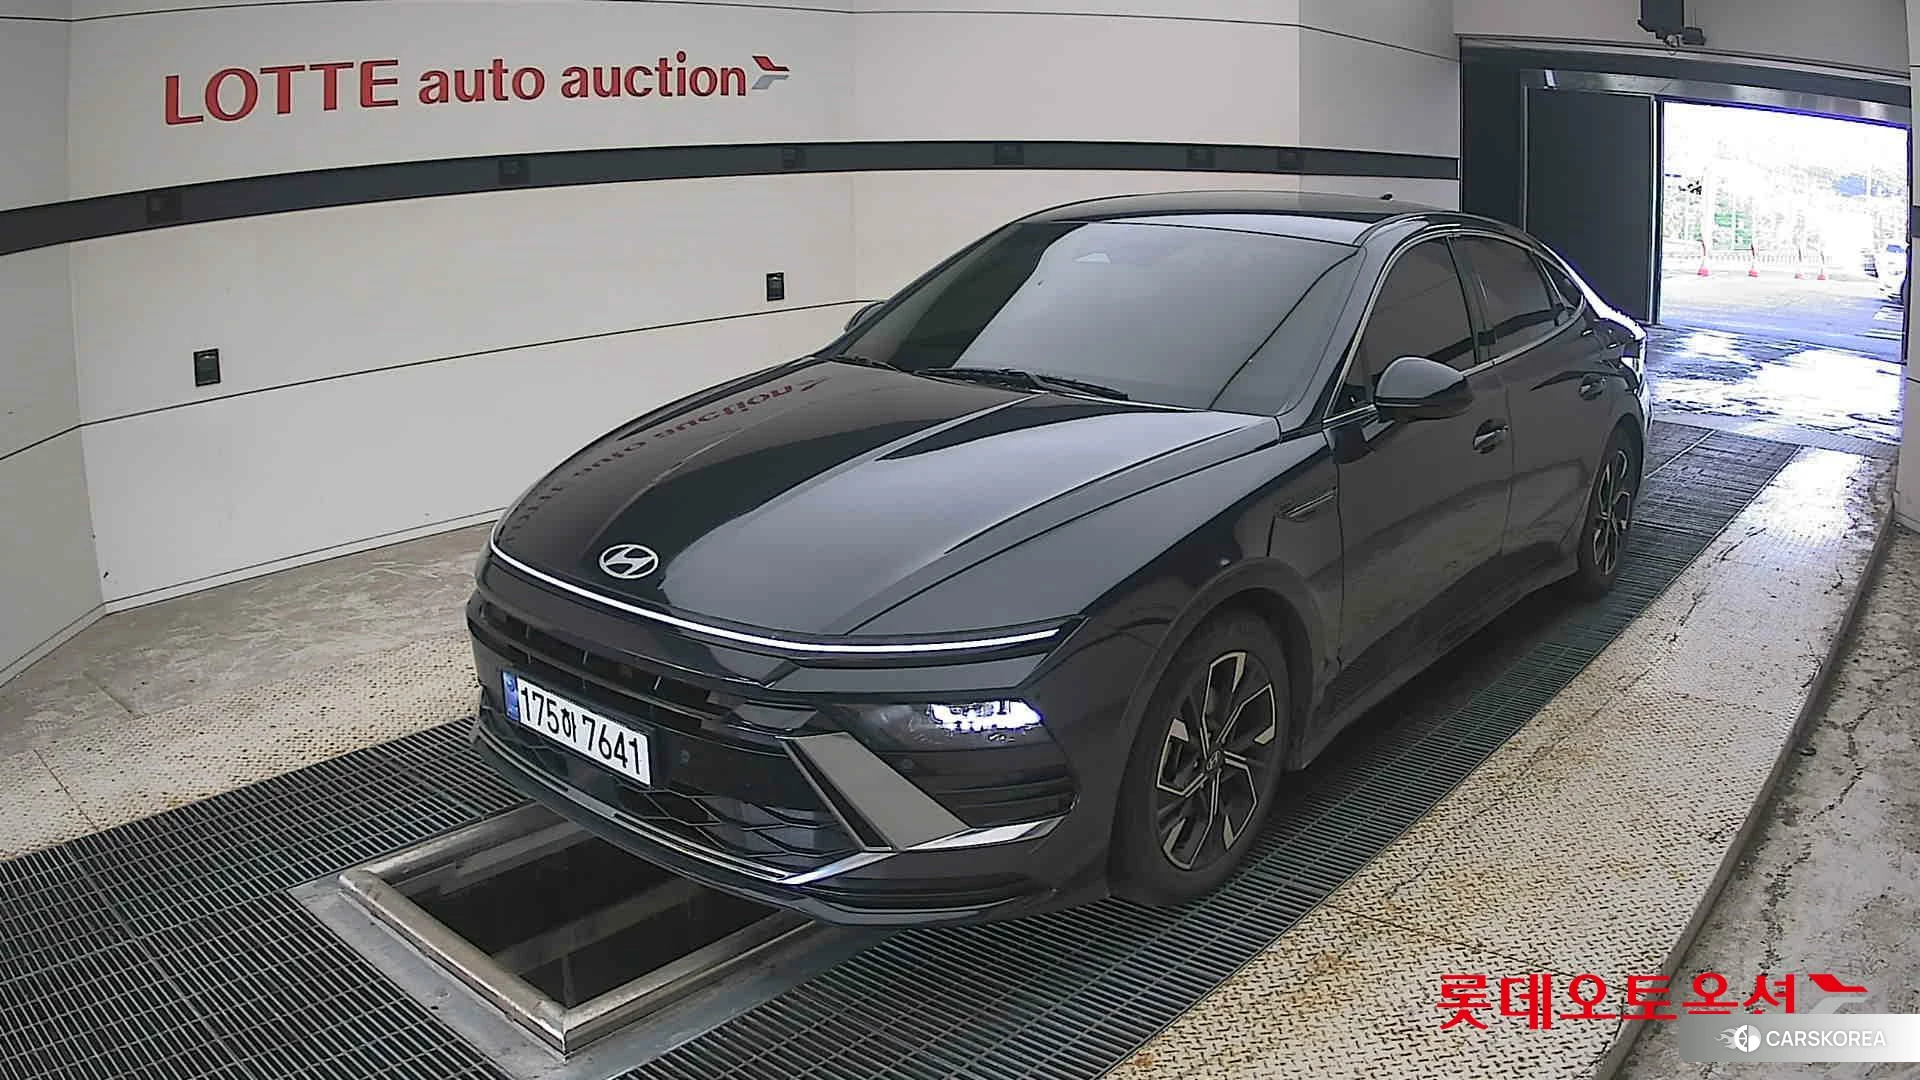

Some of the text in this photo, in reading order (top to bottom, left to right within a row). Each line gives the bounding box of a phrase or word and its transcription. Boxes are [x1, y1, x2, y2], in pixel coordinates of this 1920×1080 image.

[164, 50, 747, 125] LOTTE auto auction
[582, 714, 640, 775] 7641
